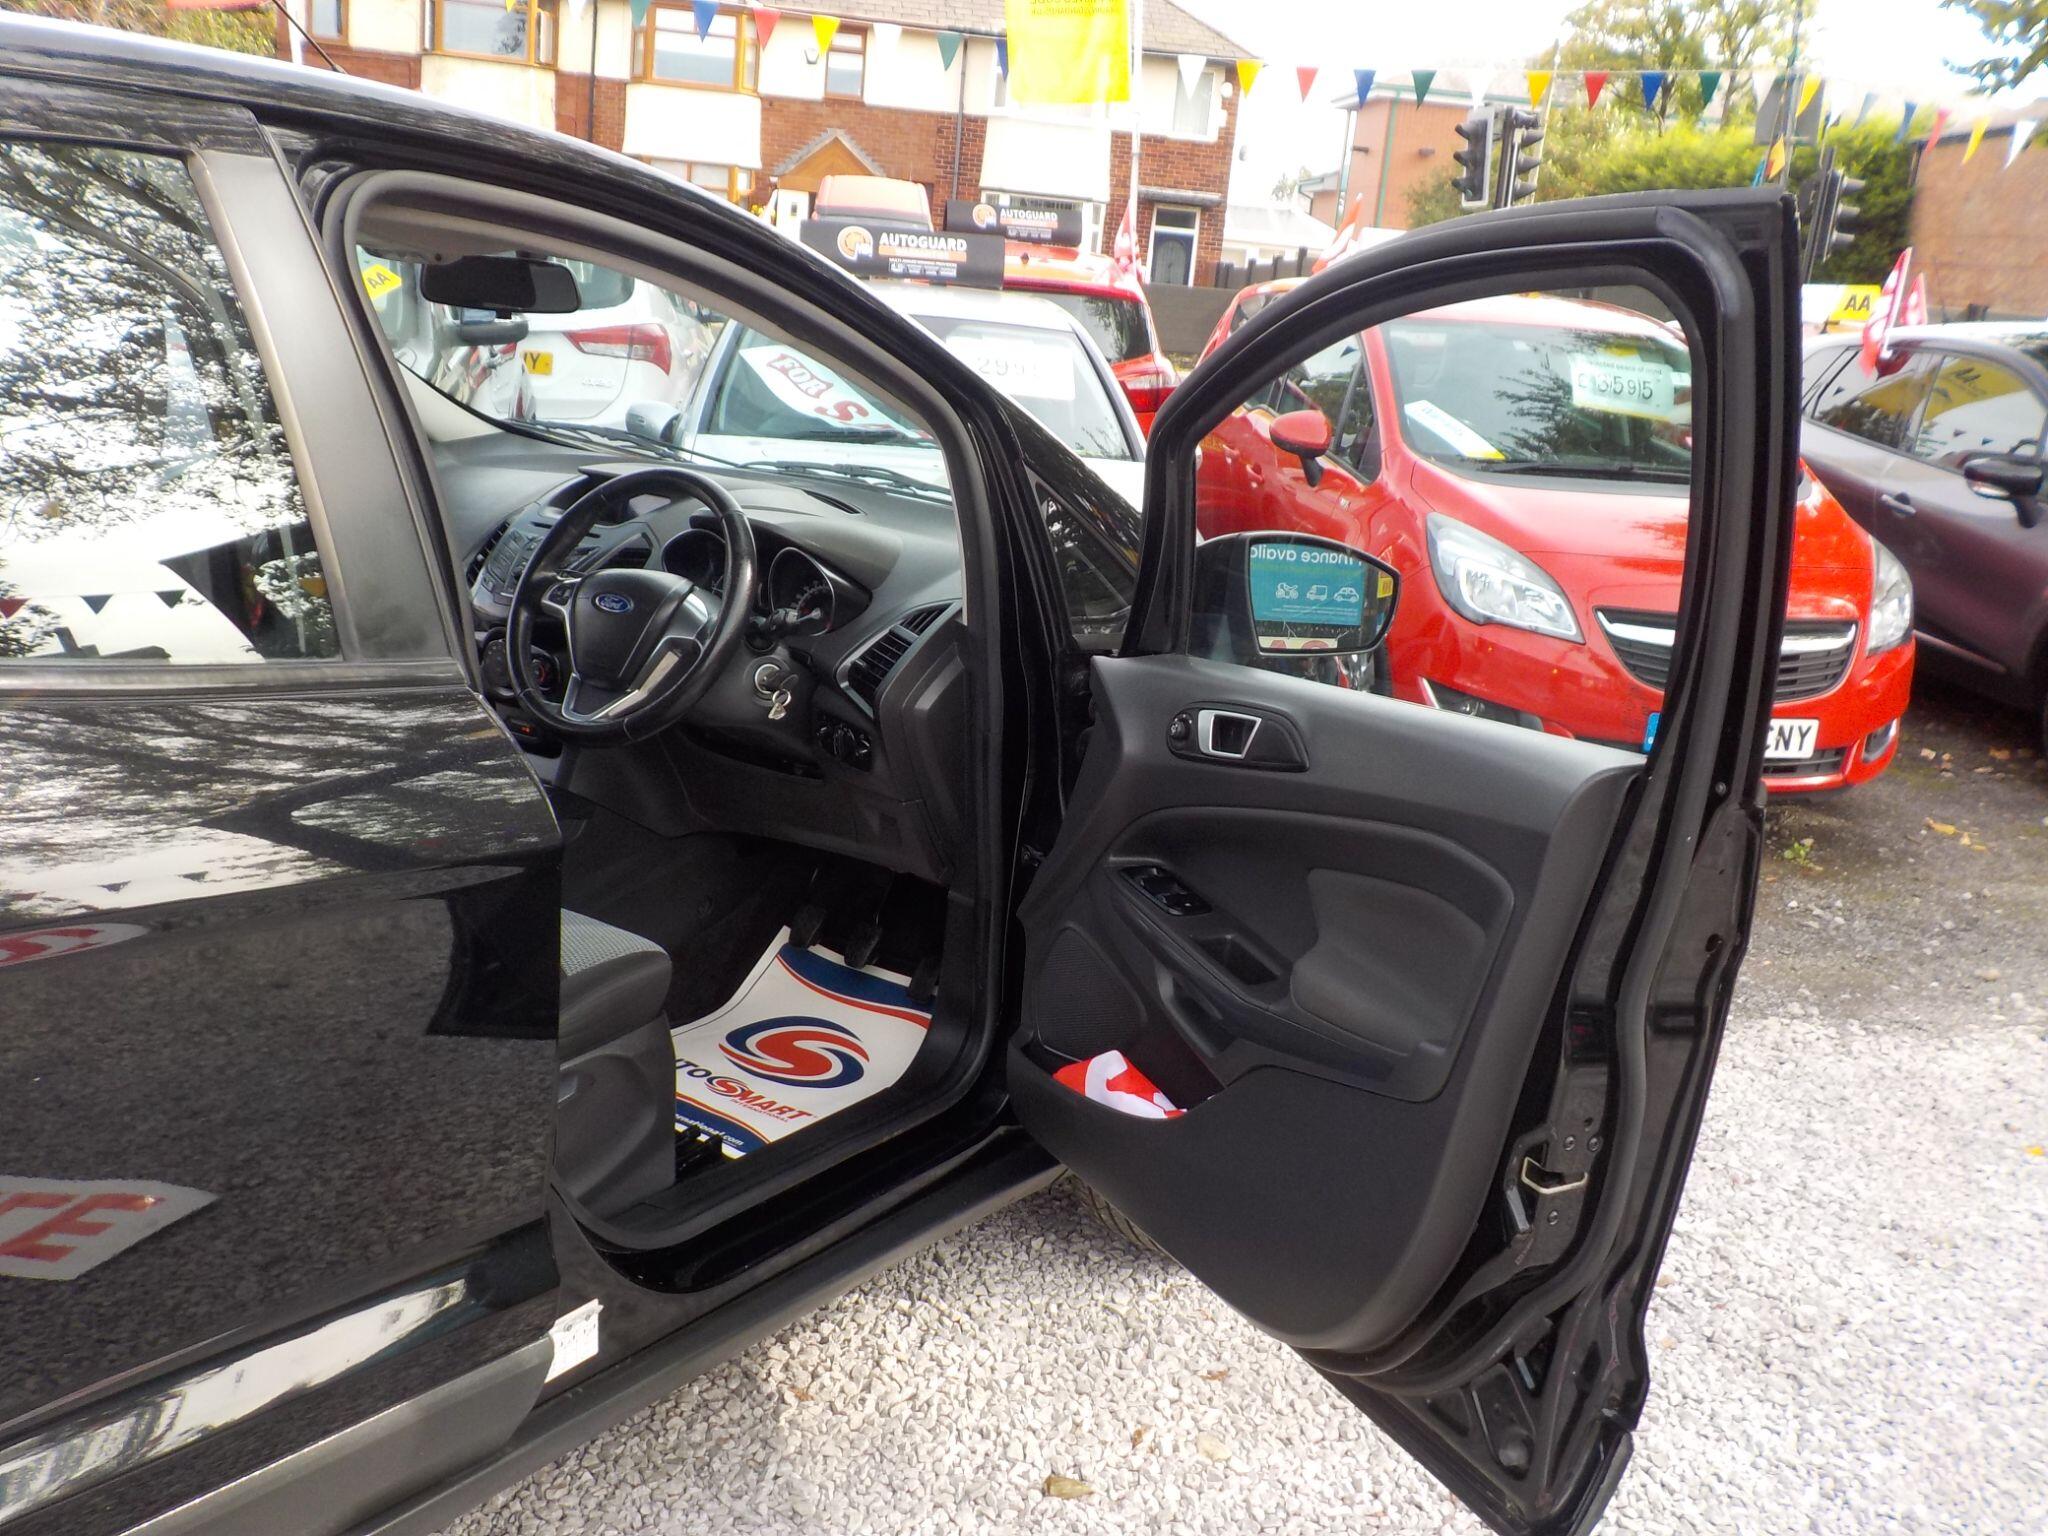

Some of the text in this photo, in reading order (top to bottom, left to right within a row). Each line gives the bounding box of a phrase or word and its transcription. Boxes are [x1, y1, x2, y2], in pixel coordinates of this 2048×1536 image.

[1000, 208, 1058, 221] AUTOGUARD
[879, 232, 968, 251] AUTOGUARD
[367, 271, 391, 290] AA
[1844, 295, 1871, 312] AA
[767, 353, 834, 400] FOR
[600, 596, 624, 609] Ford
